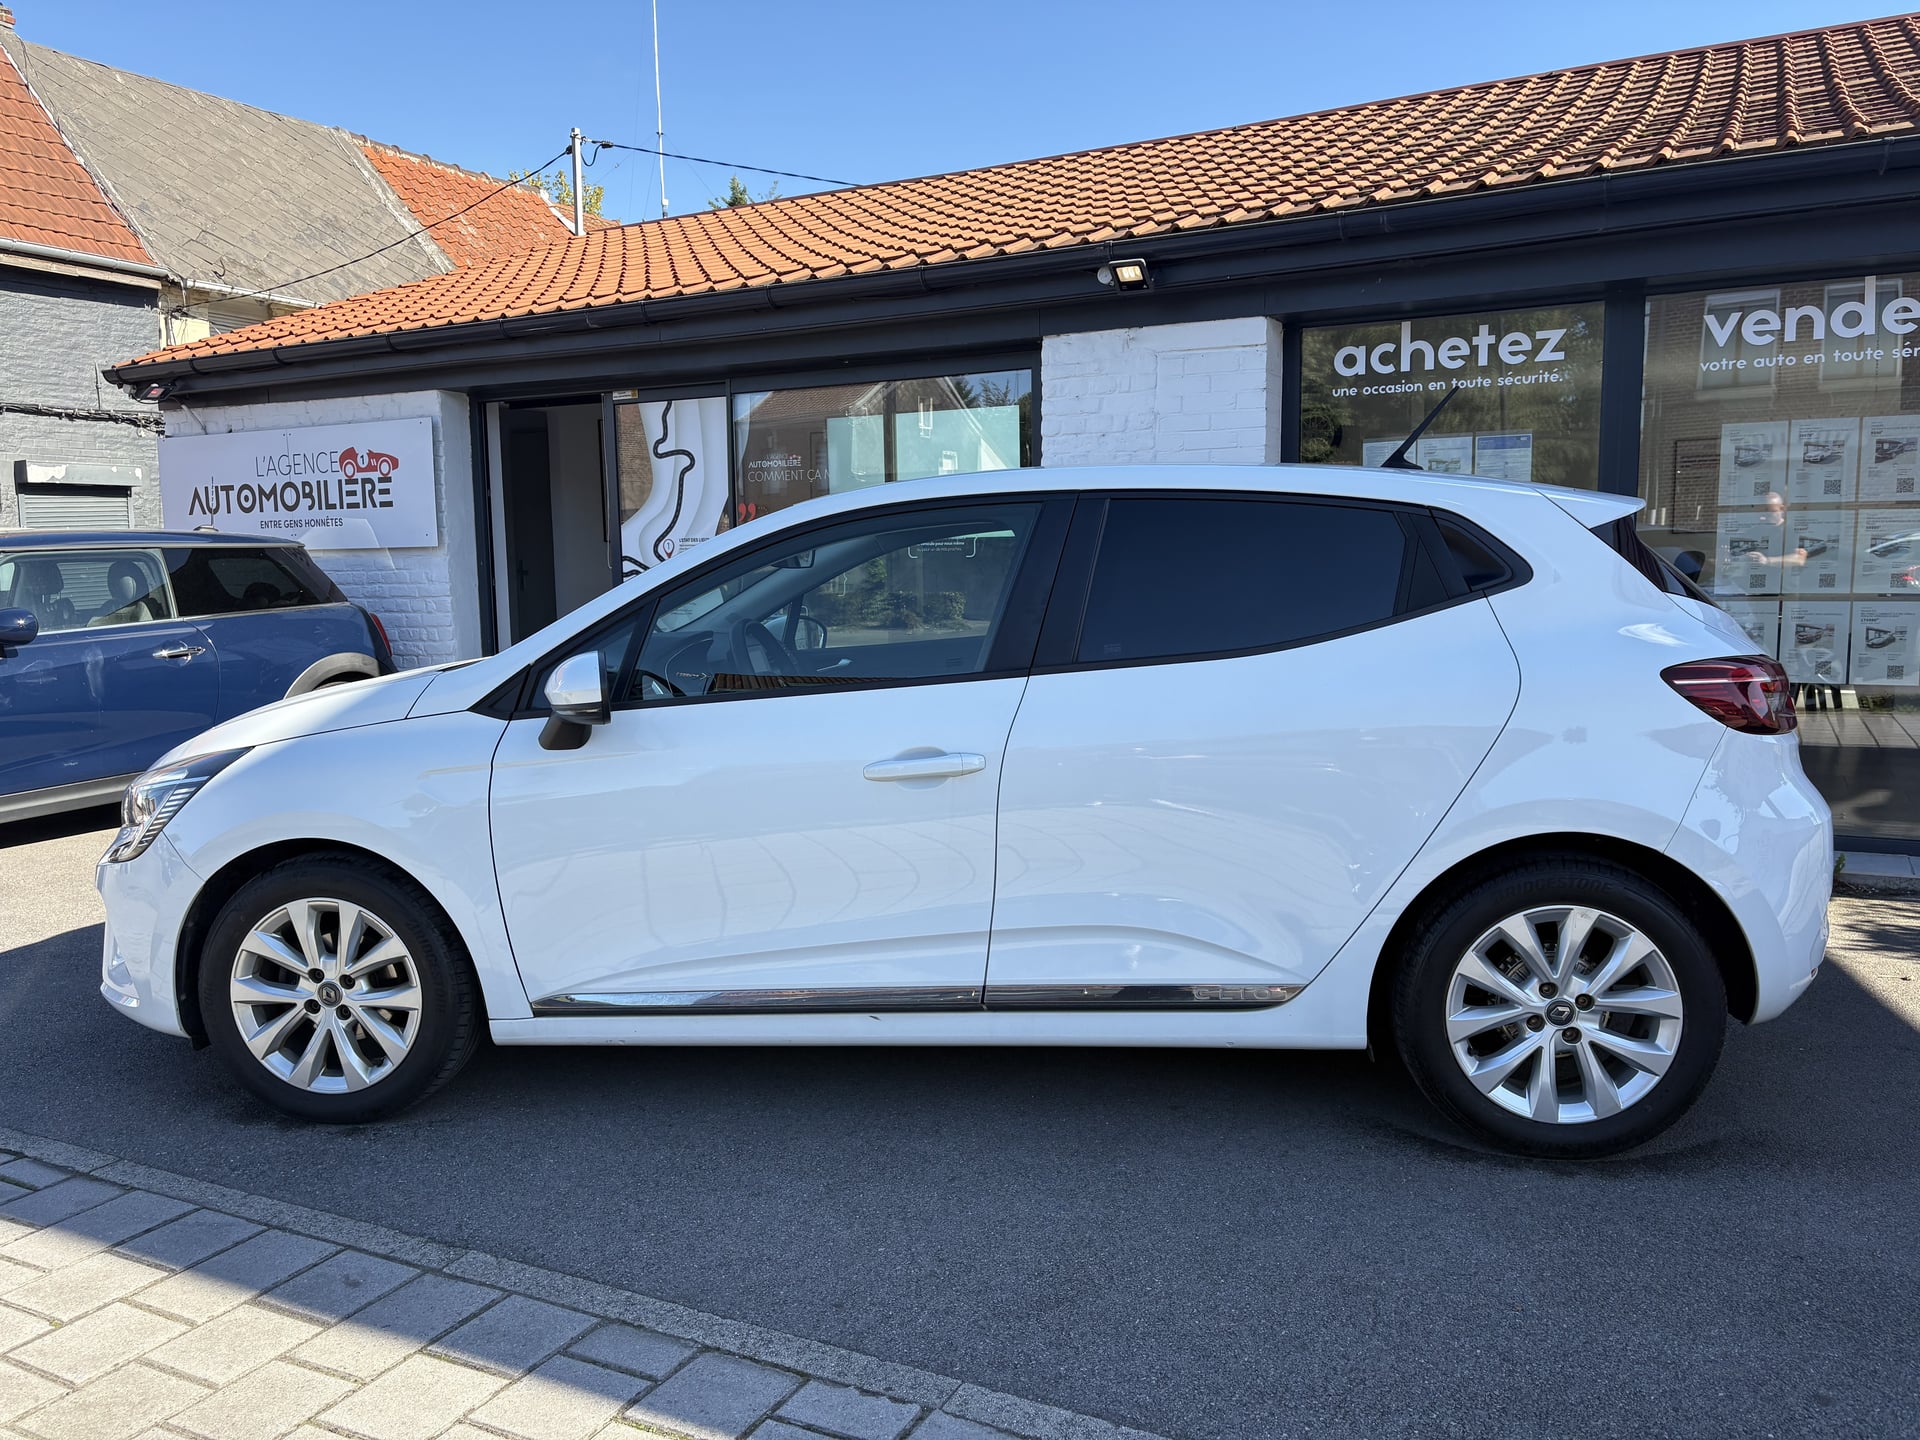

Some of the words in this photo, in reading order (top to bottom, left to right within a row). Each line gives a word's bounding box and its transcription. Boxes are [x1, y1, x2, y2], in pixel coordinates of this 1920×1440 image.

[1333, 321, 1568, 377] achetez
[1700, 357, 1748, 372] votre
[1753, 354, 1797, 368] auto
[1803, 352, 1825, 365] en
[1833, 346, 1885, 362] toute
[1332, 386, 1358, 397] une
[1362, 379, 1423, 396] occasion
[1428, 380, 1446, 391] en
[1451, 375, 1492, 389] toute
[1497, 367, 1564, 386] sécurité.
[255, 450, 339, 478] L'AGENCE
[747, 469, 805, 483] COMMENT
[806, 468, 822, 483] ÇA
[260, 519, 283, 530] ENTRE
[283, 518, 303, 529] GENS
[304, 515, 344, 528] HONNÊTES
[1193, 986, 1272, 1000] CLIO
